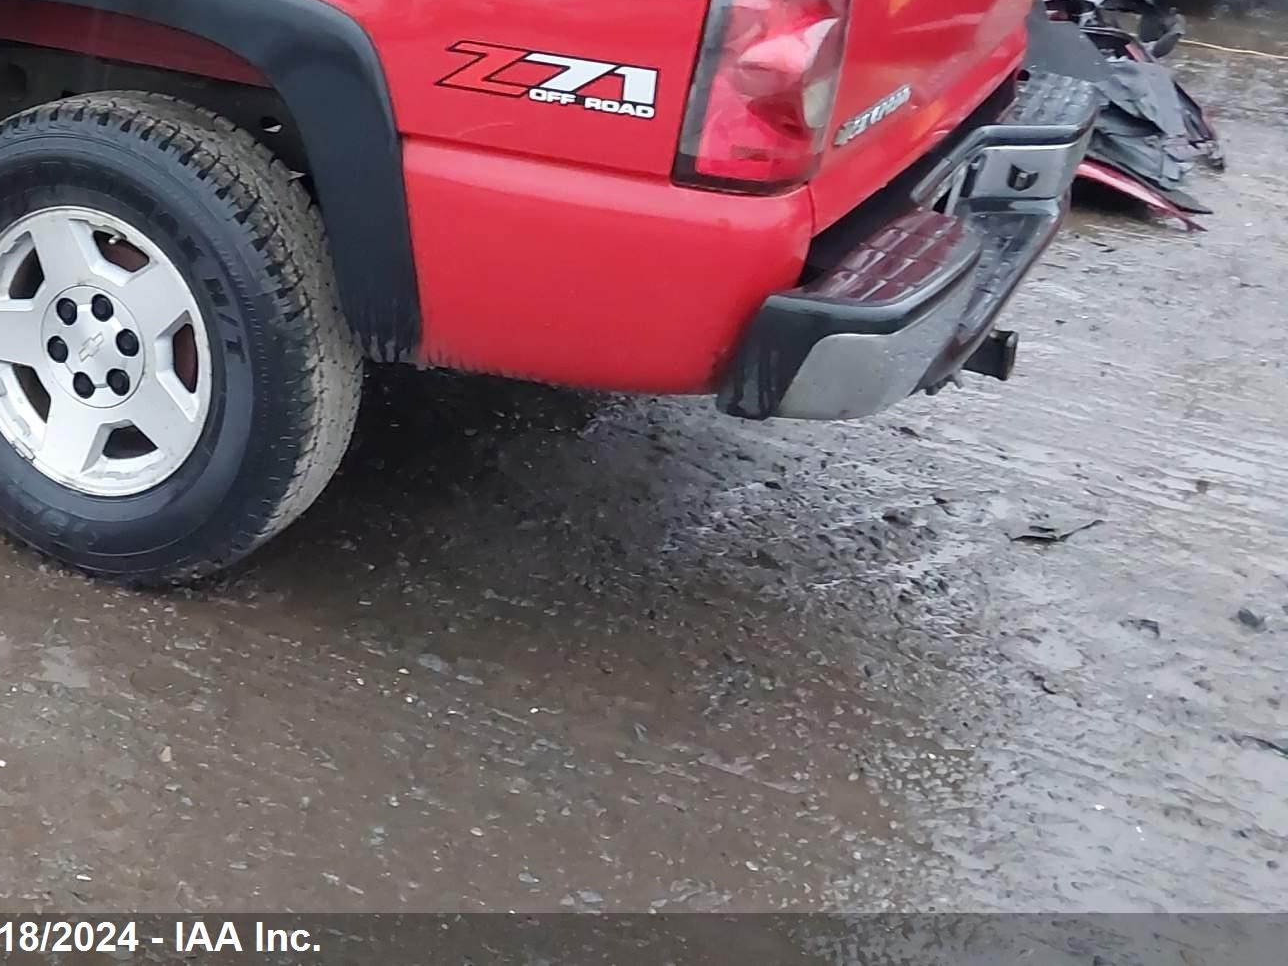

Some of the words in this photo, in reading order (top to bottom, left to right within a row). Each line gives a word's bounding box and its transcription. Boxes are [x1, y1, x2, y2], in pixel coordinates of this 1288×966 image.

[434, 40, 659, 105] Z71
[528, 87, 576, 105] OFF
[583, 97, 656, 120] ROAD
